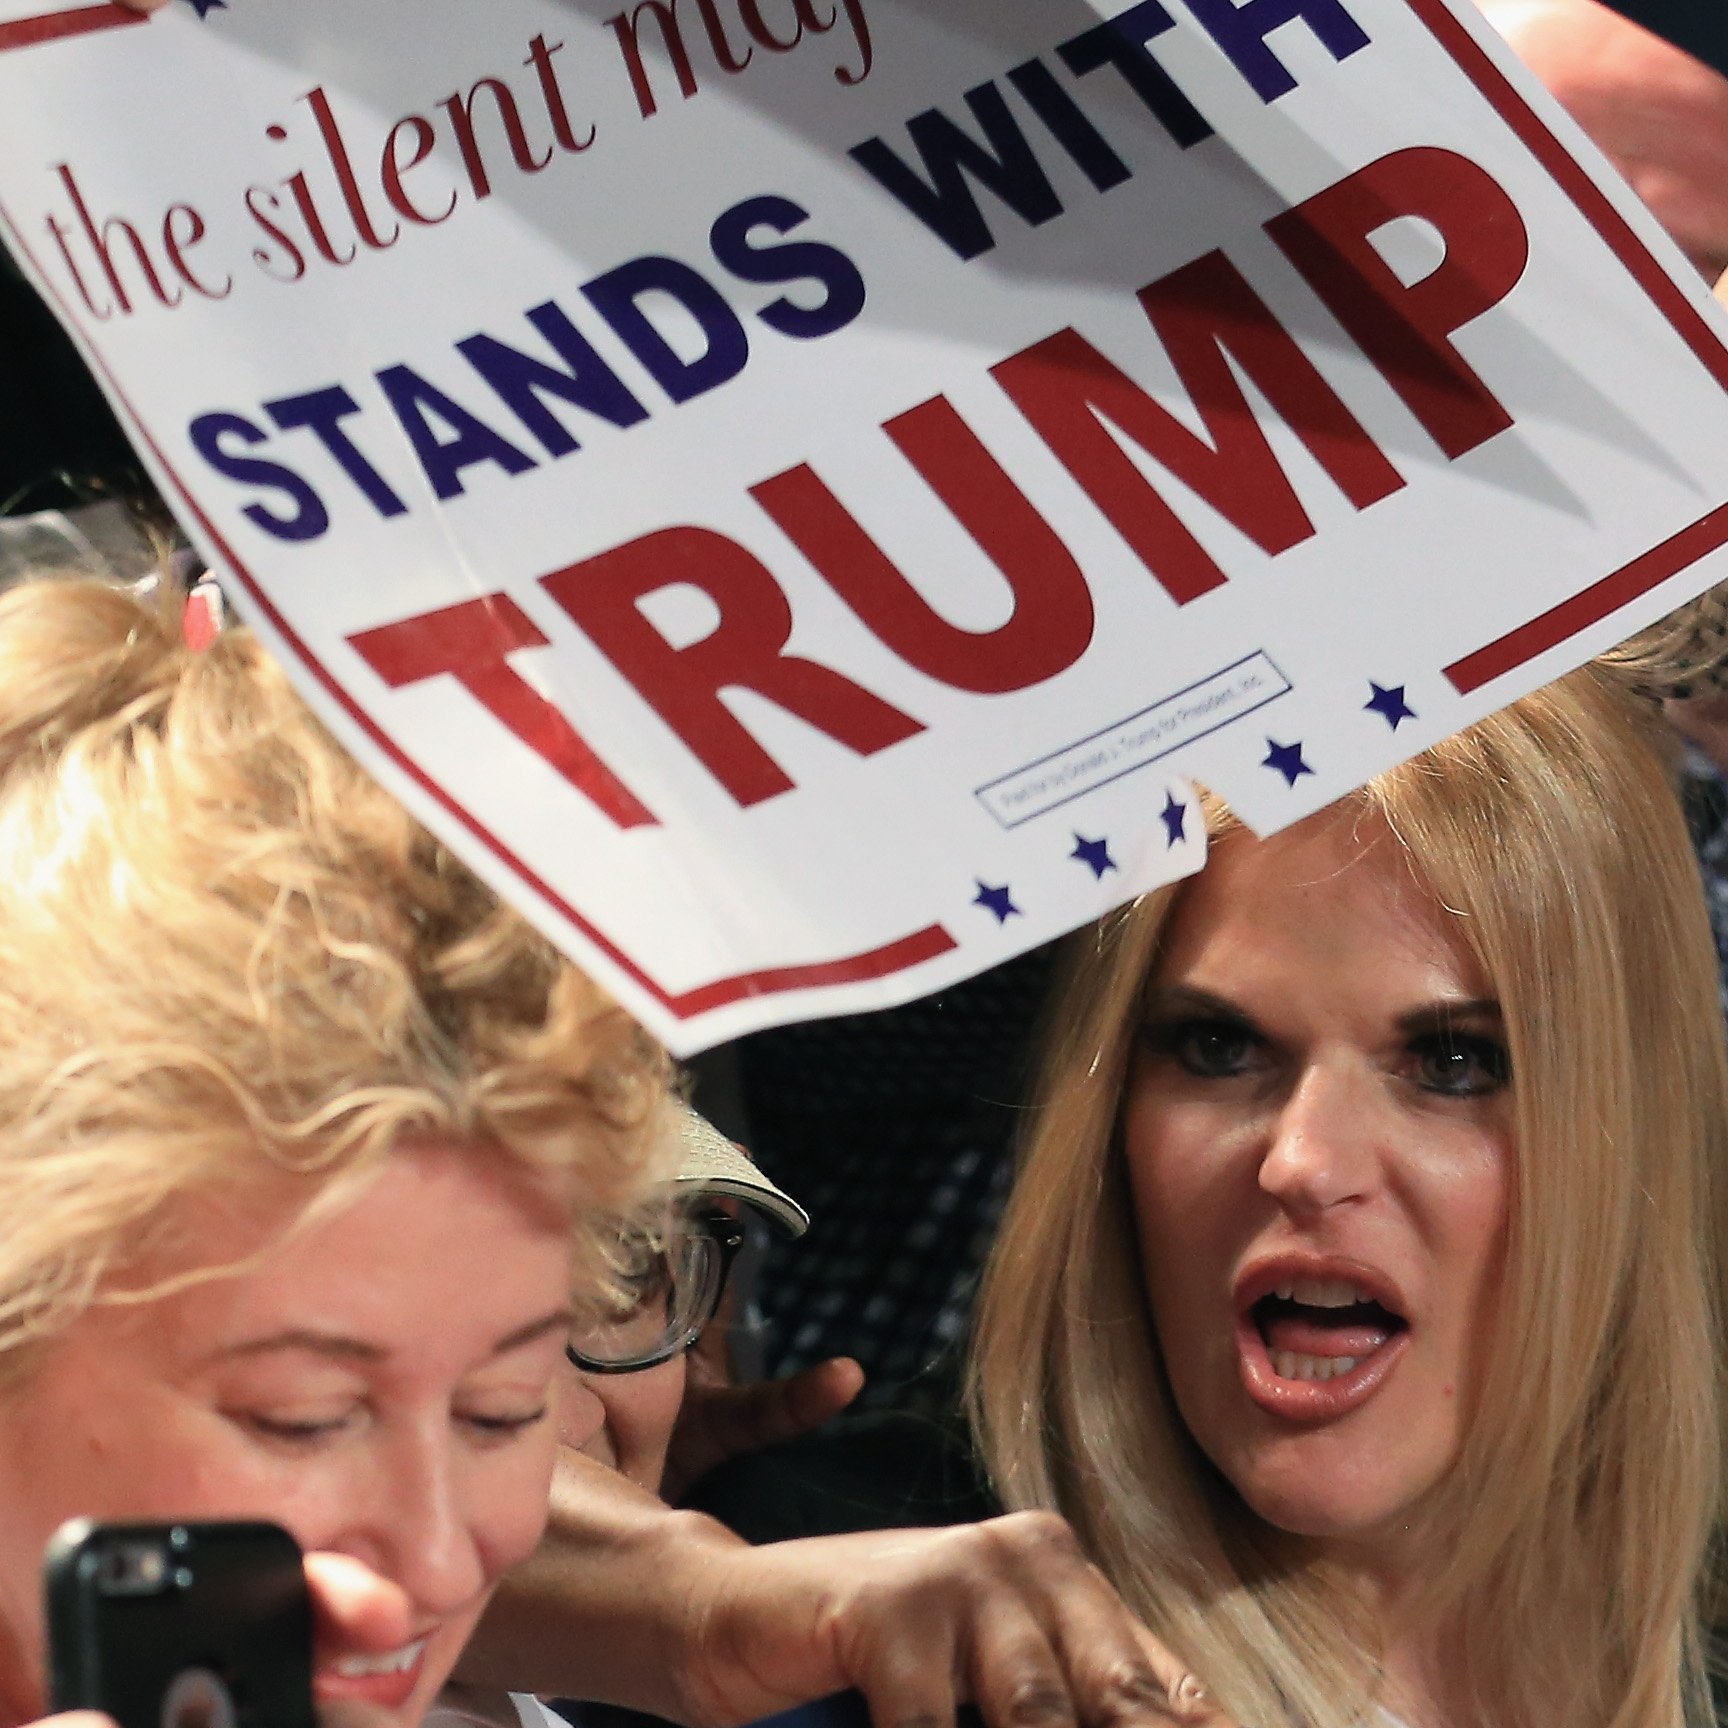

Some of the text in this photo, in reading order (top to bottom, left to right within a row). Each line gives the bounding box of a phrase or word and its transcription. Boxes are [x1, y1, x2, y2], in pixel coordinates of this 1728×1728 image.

[44, 162, 232, 322] the
[242, 31, 599, 284] silent
[186, 0, 1372, 541] STANDS WITH
[345, 146, 1529, 830] TRUMP
